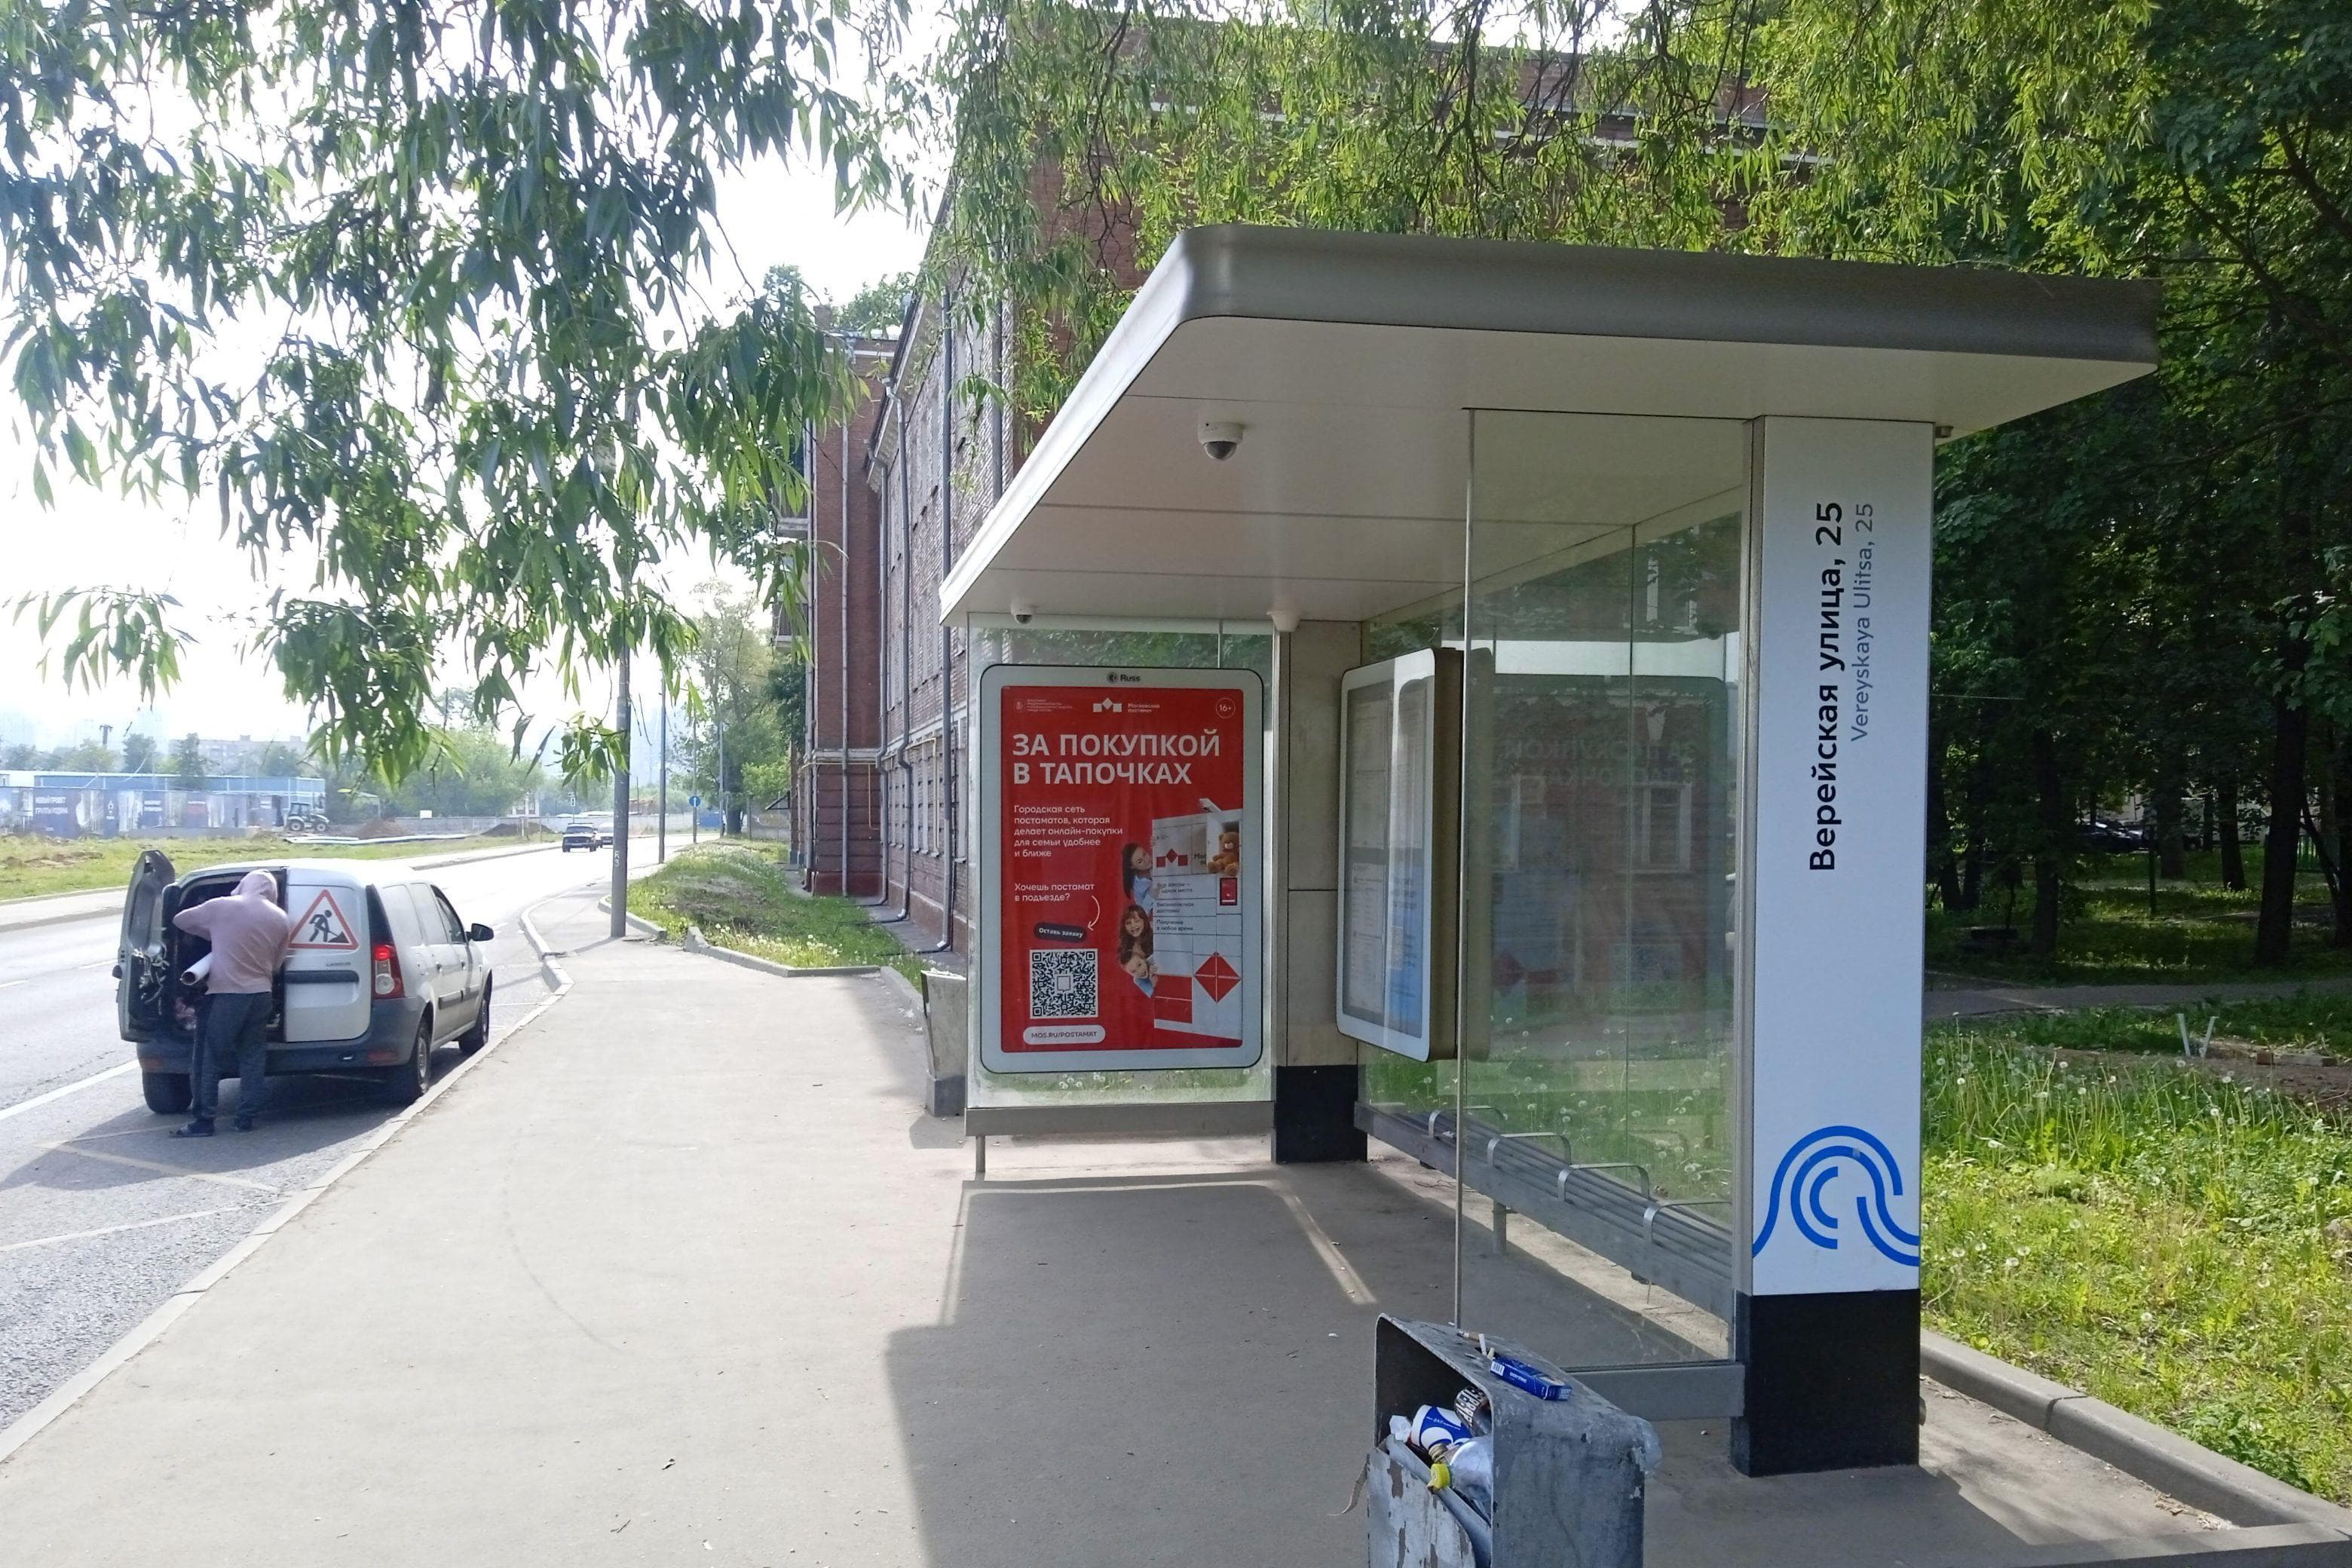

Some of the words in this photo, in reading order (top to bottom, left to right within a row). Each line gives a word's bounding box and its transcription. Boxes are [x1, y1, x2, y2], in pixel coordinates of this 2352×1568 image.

[1815, 502, 1842, 546] 25
[1855, 504, 1873, 532] 25
[1853, 541, 1875, 609] Ulitsa,
[1819, 558, 1846, 672] улица,
[1119, 674, 1141, 682] Russ
[1851, 617, 1874, 743] Vereyskaya
[1218, 703, 1233, 712] 16+
[1012, 733, 1050, 757] ЗА
[1060, 728, 1220, 757] ПОКУПКОЙ
[1014, 763, 1030, 785] В
[1040, 762, 1192, 785] ТАПОЧКАХ
[1809, 684, 1842, 871] Верейская
[1014, 805, 1063, 815] Городская
[1073, 817, 1110, 826] которая
[1048, 826, 1123, 837] онлайн-покупки
[1063, 838, 1101, 847] удобнее
[1014, 883, 1049, 891] Хочешь
[1022, 893, 1070, 902] подъезде?
[1038, 926, 1061, 936] Оставь
[1061, 929, 1084, 939] заявку
[1031, 1031, 1098, 1039] MOS.RU/POSTAMAT
